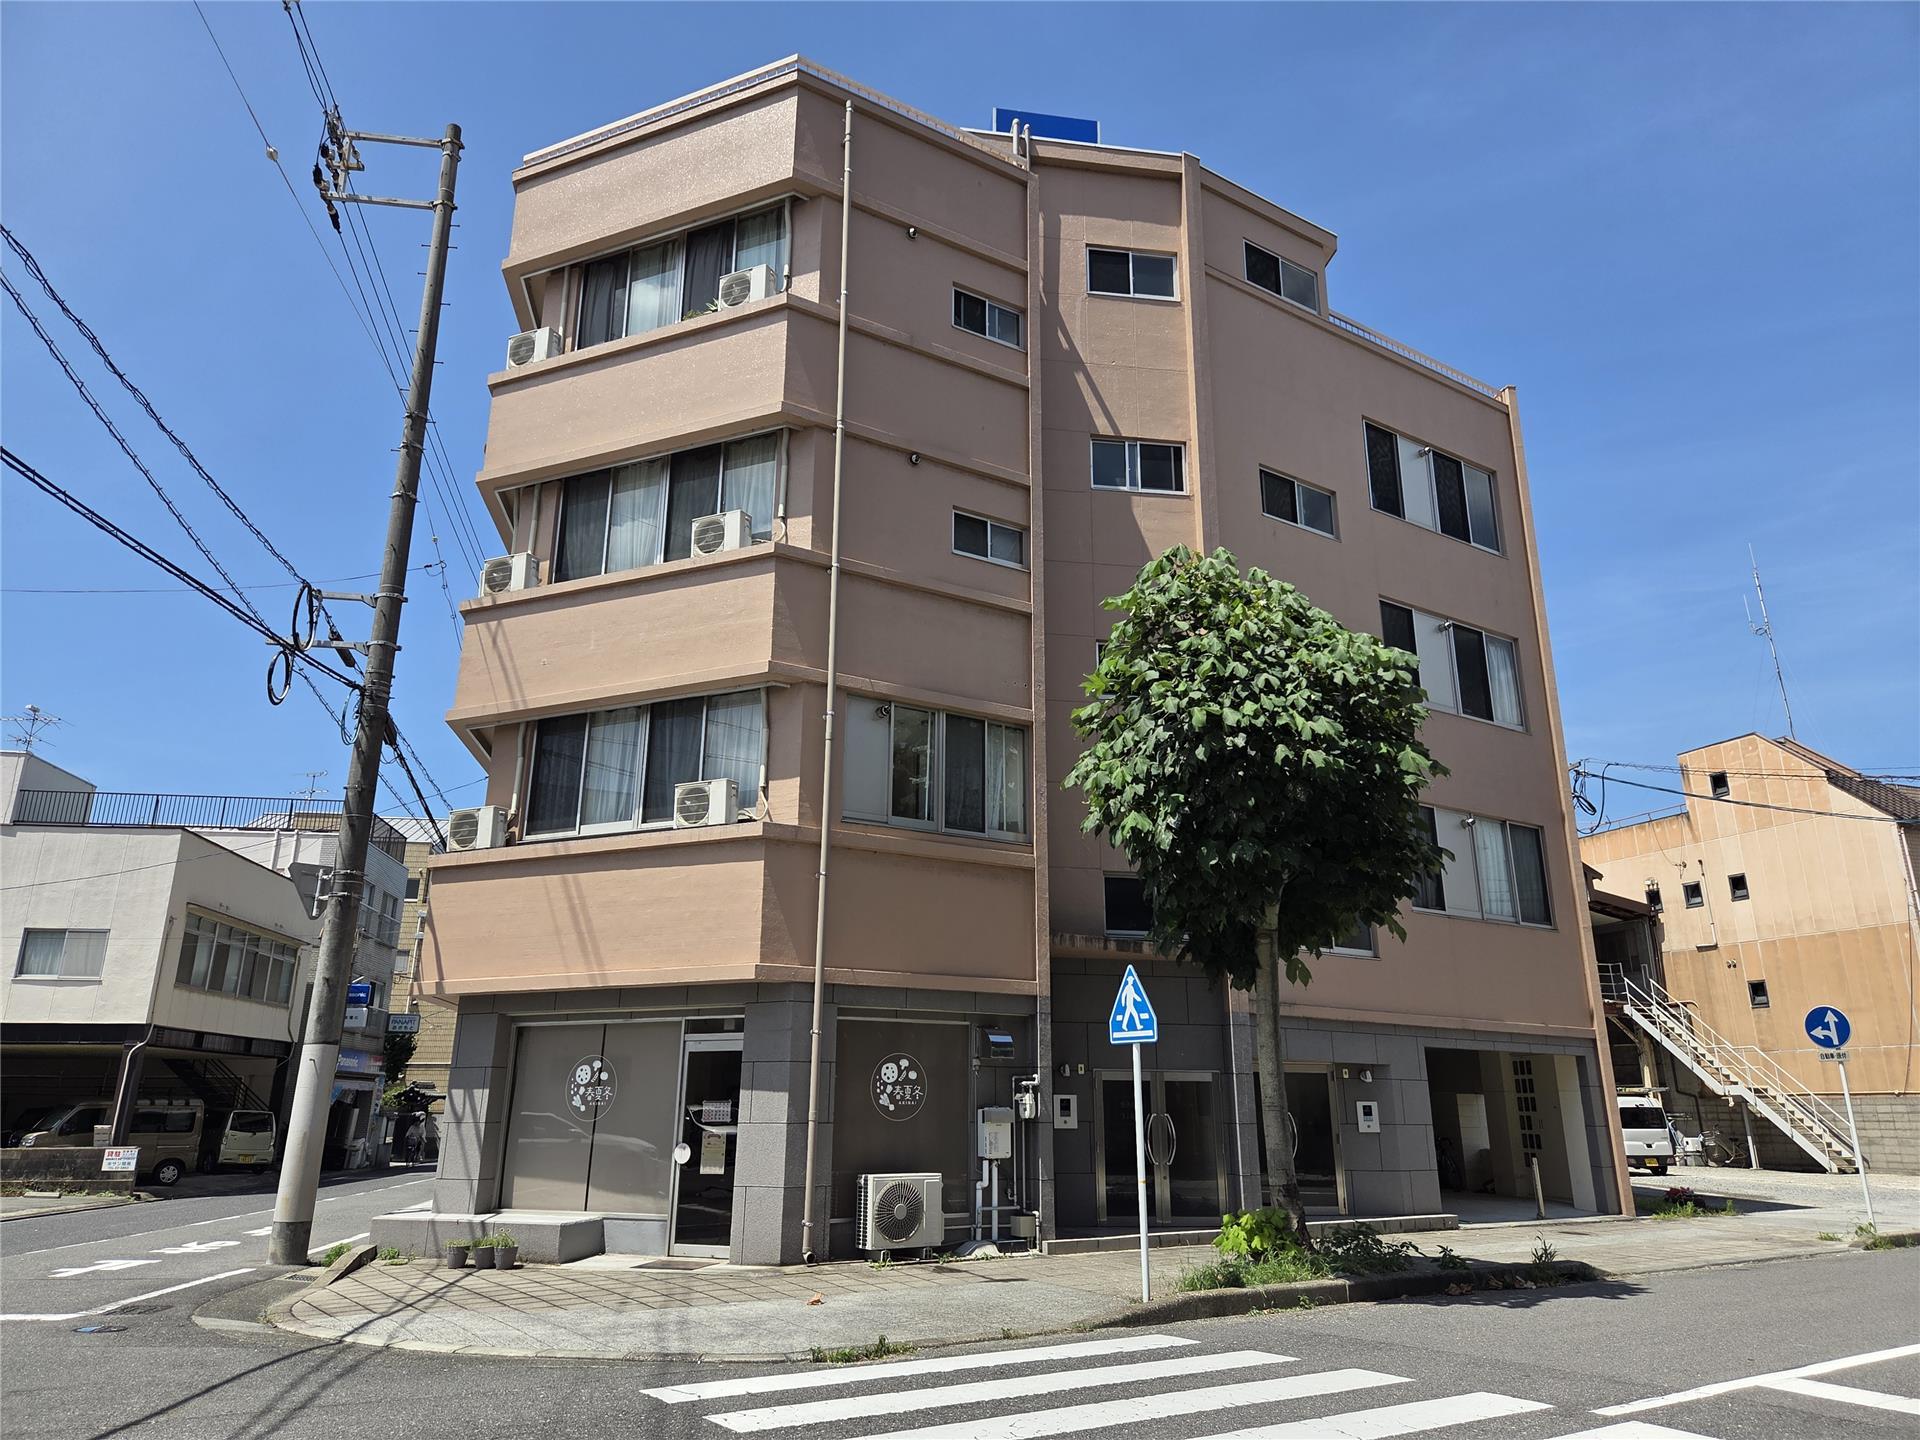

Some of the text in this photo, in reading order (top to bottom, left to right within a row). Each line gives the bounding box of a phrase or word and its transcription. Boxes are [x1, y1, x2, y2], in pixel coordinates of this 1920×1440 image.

[585, 1087, 613, 1100] 春夏冬
[893, 1085, 923, 1100] 春夏冬
